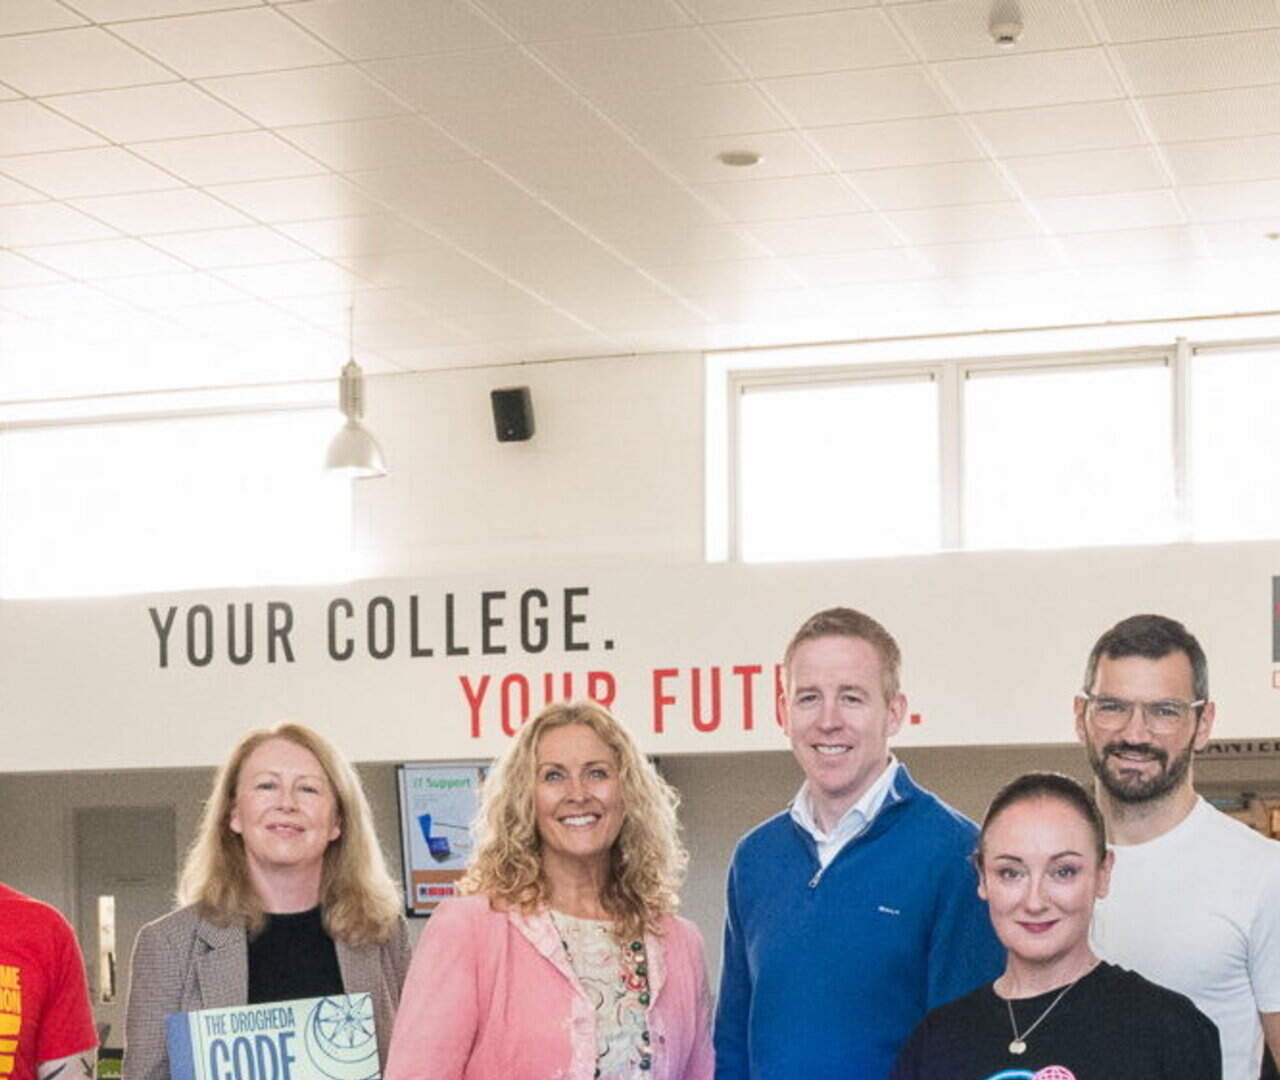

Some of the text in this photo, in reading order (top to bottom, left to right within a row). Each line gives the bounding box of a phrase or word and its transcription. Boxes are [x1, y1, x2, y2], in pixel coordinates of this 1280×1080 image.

[149, 587, 615, 668] YOUR COLLEGE.
[426, 778, 470, 790] Support
[205, 1007, 295, 1035] THE DROGHEDA
